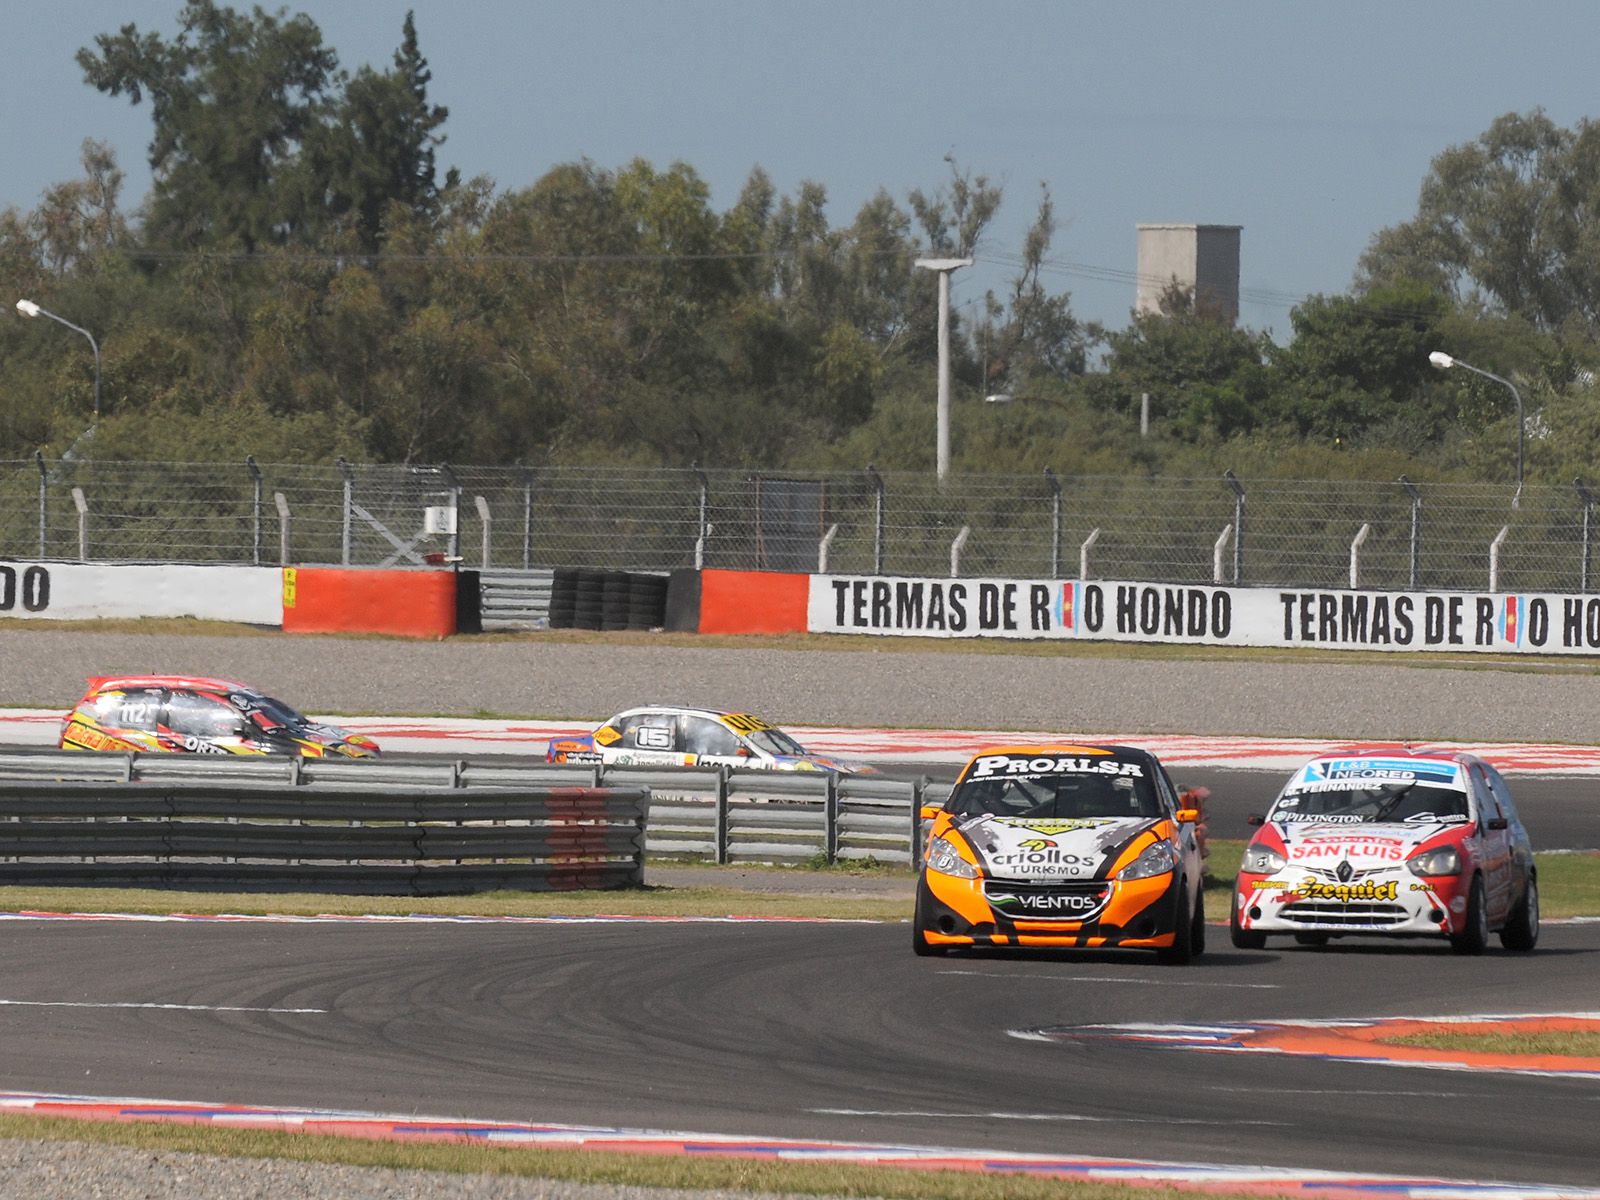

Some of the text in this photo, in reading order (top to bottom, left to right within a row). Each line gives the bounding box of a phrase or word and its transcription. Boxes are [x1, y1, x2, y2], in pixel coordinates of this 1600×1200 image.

[832, 580, 967, 632] TERMAS
[979, 583, 1018, 631] DE
[1116, 585, 1232, 639] HONDO
[1280, 593, 1414, 645] TERMAS
[1425, 595, 1464, 645] DE
[638, 727, 670, 748] 15
[973, 755, 1144, 778] PROALSA
[1335, 769, 1415, 779] NEORED
[1285, 811, 1364, 823] PILKINGTON
[991, 850, 1095, 867] criollos
[1292, 845, 1404, 861] SAN LUIS
[1010, 865, 1080, 876] TURISMO
[1292, 876, 1400, 903] Ezequiel
[1018, 895, 1096, 909] VIENTOS
